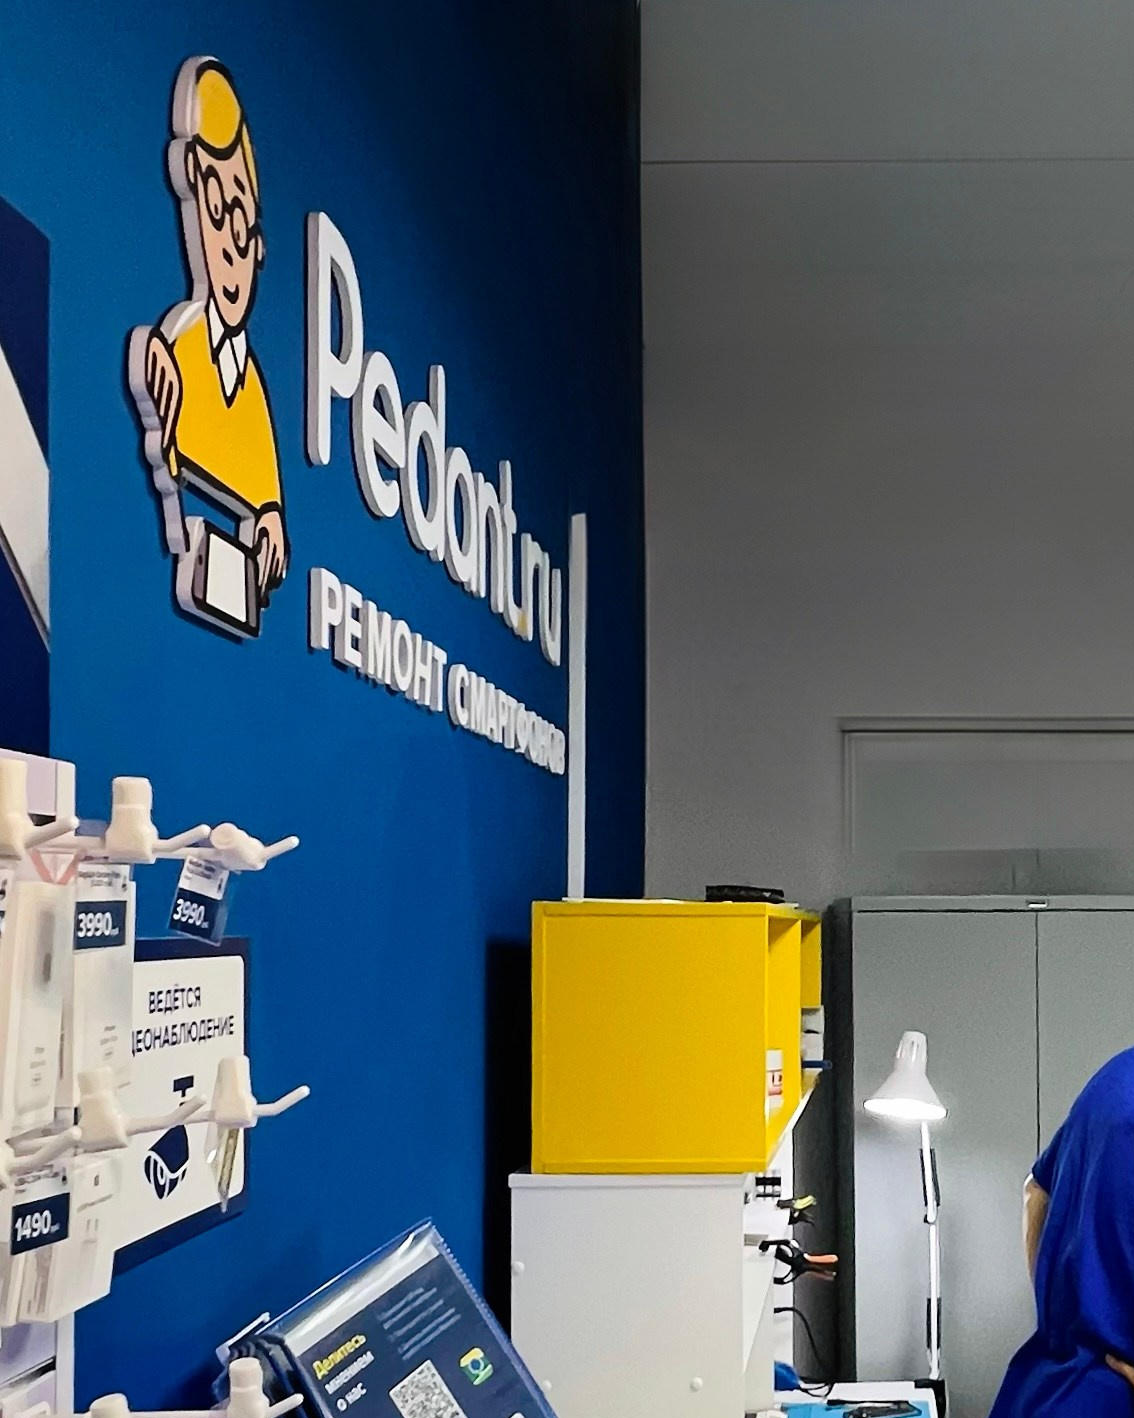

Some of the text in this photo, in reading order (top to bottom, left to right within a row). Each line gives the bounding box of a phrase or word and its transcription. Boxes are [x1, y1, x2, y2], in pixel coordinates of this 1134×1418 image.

[307, 211, 562, 667] Pedant.ru
[310, 566, 448, 713] РЕМОНТ
[77, 912, 112, 937] 3990
[173, 898, 206, 926] 3990
[148, 983, 201, 1014] ВЕДЁТСЯ
[131, 1015, 234, 1058] ЕОНАБЛЮДЕНИЕ
[15, 1209, 52, 1242] 1490
